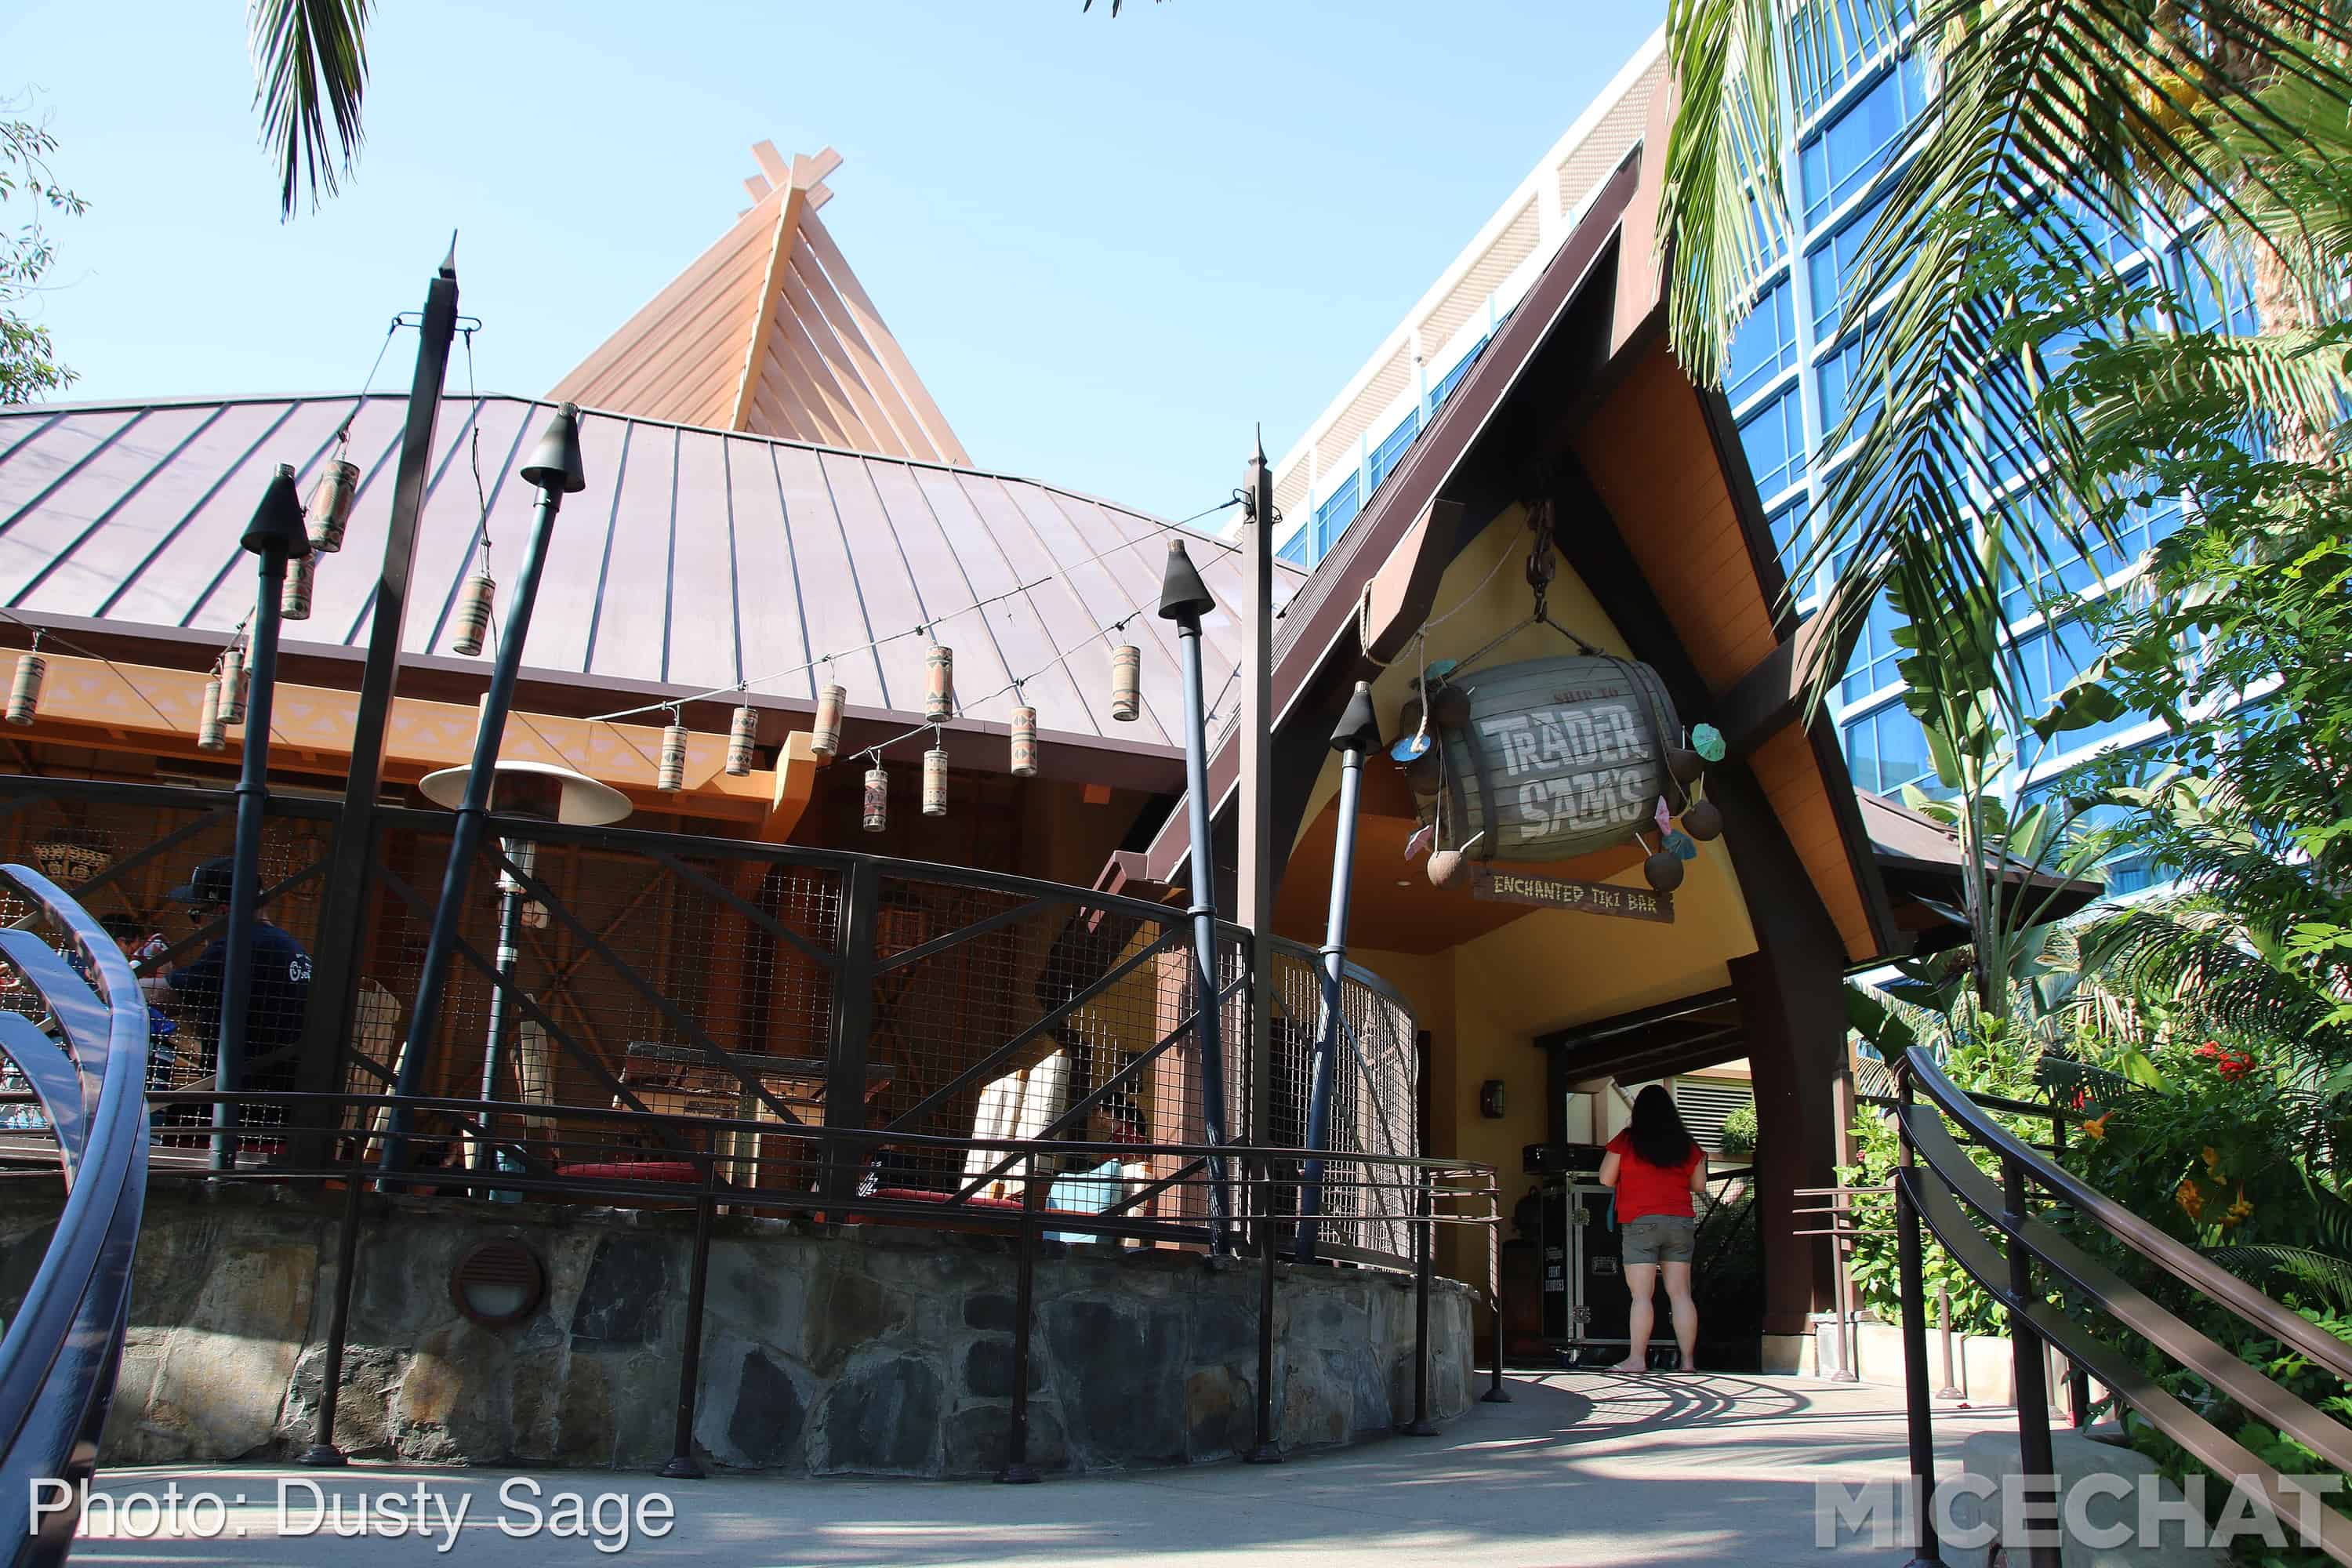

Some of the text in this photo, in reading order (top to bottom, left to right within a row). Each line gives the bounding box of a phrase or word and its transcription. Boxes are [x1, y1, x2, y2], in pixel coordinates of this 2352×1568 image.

[1553, 687, 1619, 702] SHIP TO
[1480, 705, 1648, 776] TRADER
[1519, 768, 1643, 838] SAM'S
[1493, 875, 1657, 913] ENCHANTED TIKI BAR
